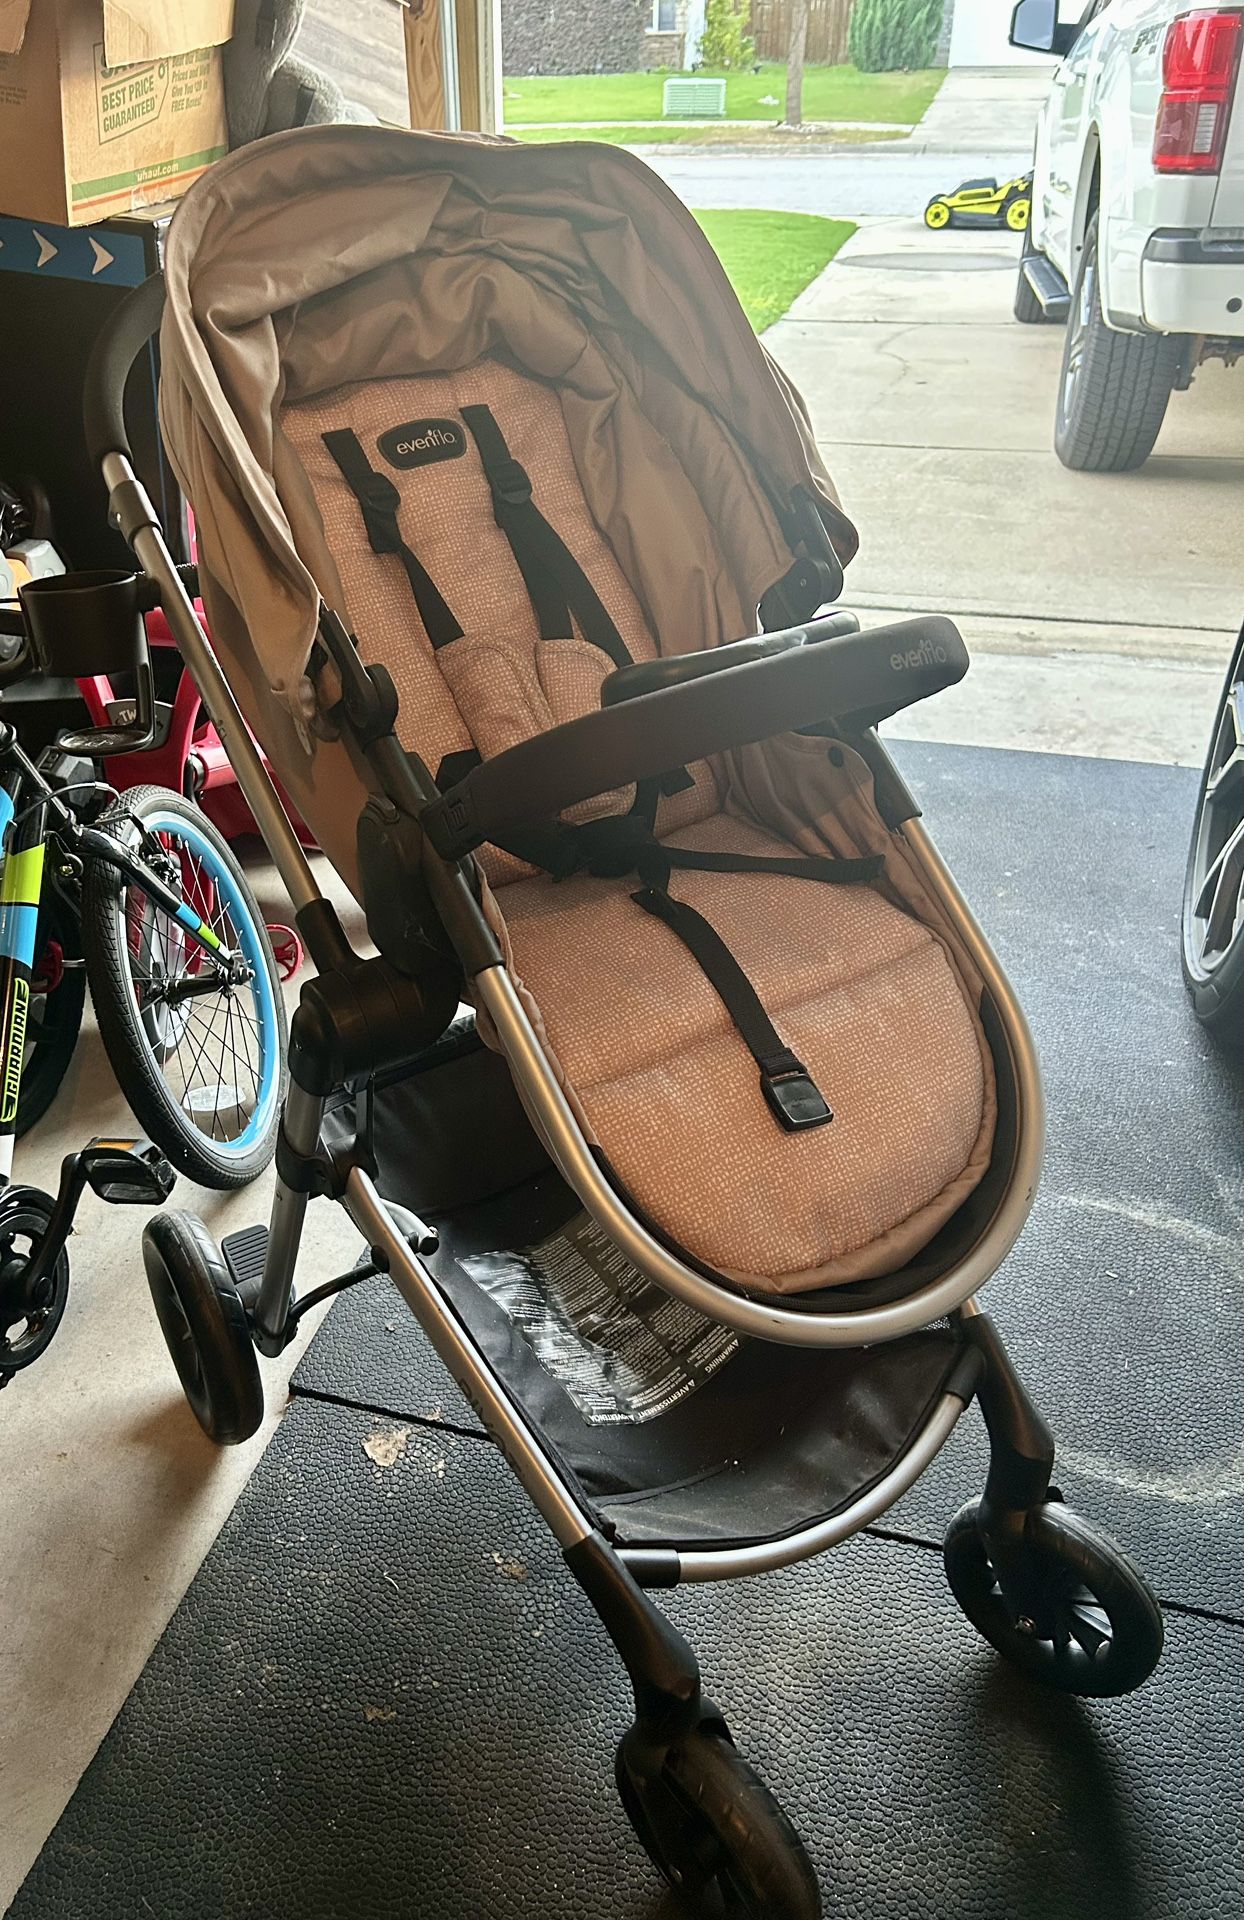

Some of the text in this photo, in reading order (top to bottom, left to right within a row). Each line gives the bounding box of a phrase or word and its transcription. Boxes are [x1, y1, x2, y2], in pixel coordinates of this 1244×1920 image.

[1131, 21, 1168, 54] SPORT
[101, 75, 155, 113] BEST PRICE
[171, 98, 185, 113] FREE
[103, 97, 156, 133] GUARANTEED
[137, 163, 179, 182] uhaul.com
[396, 429, 455, 455] evenflo
[889, 639, 947, 671] evenflo
[7, 1000, 27, 1096] GUARDIAN
[704, 1344, 736, 1374] WARNING
[638, 1385, 690, 1419] AVERTISSEMENT
